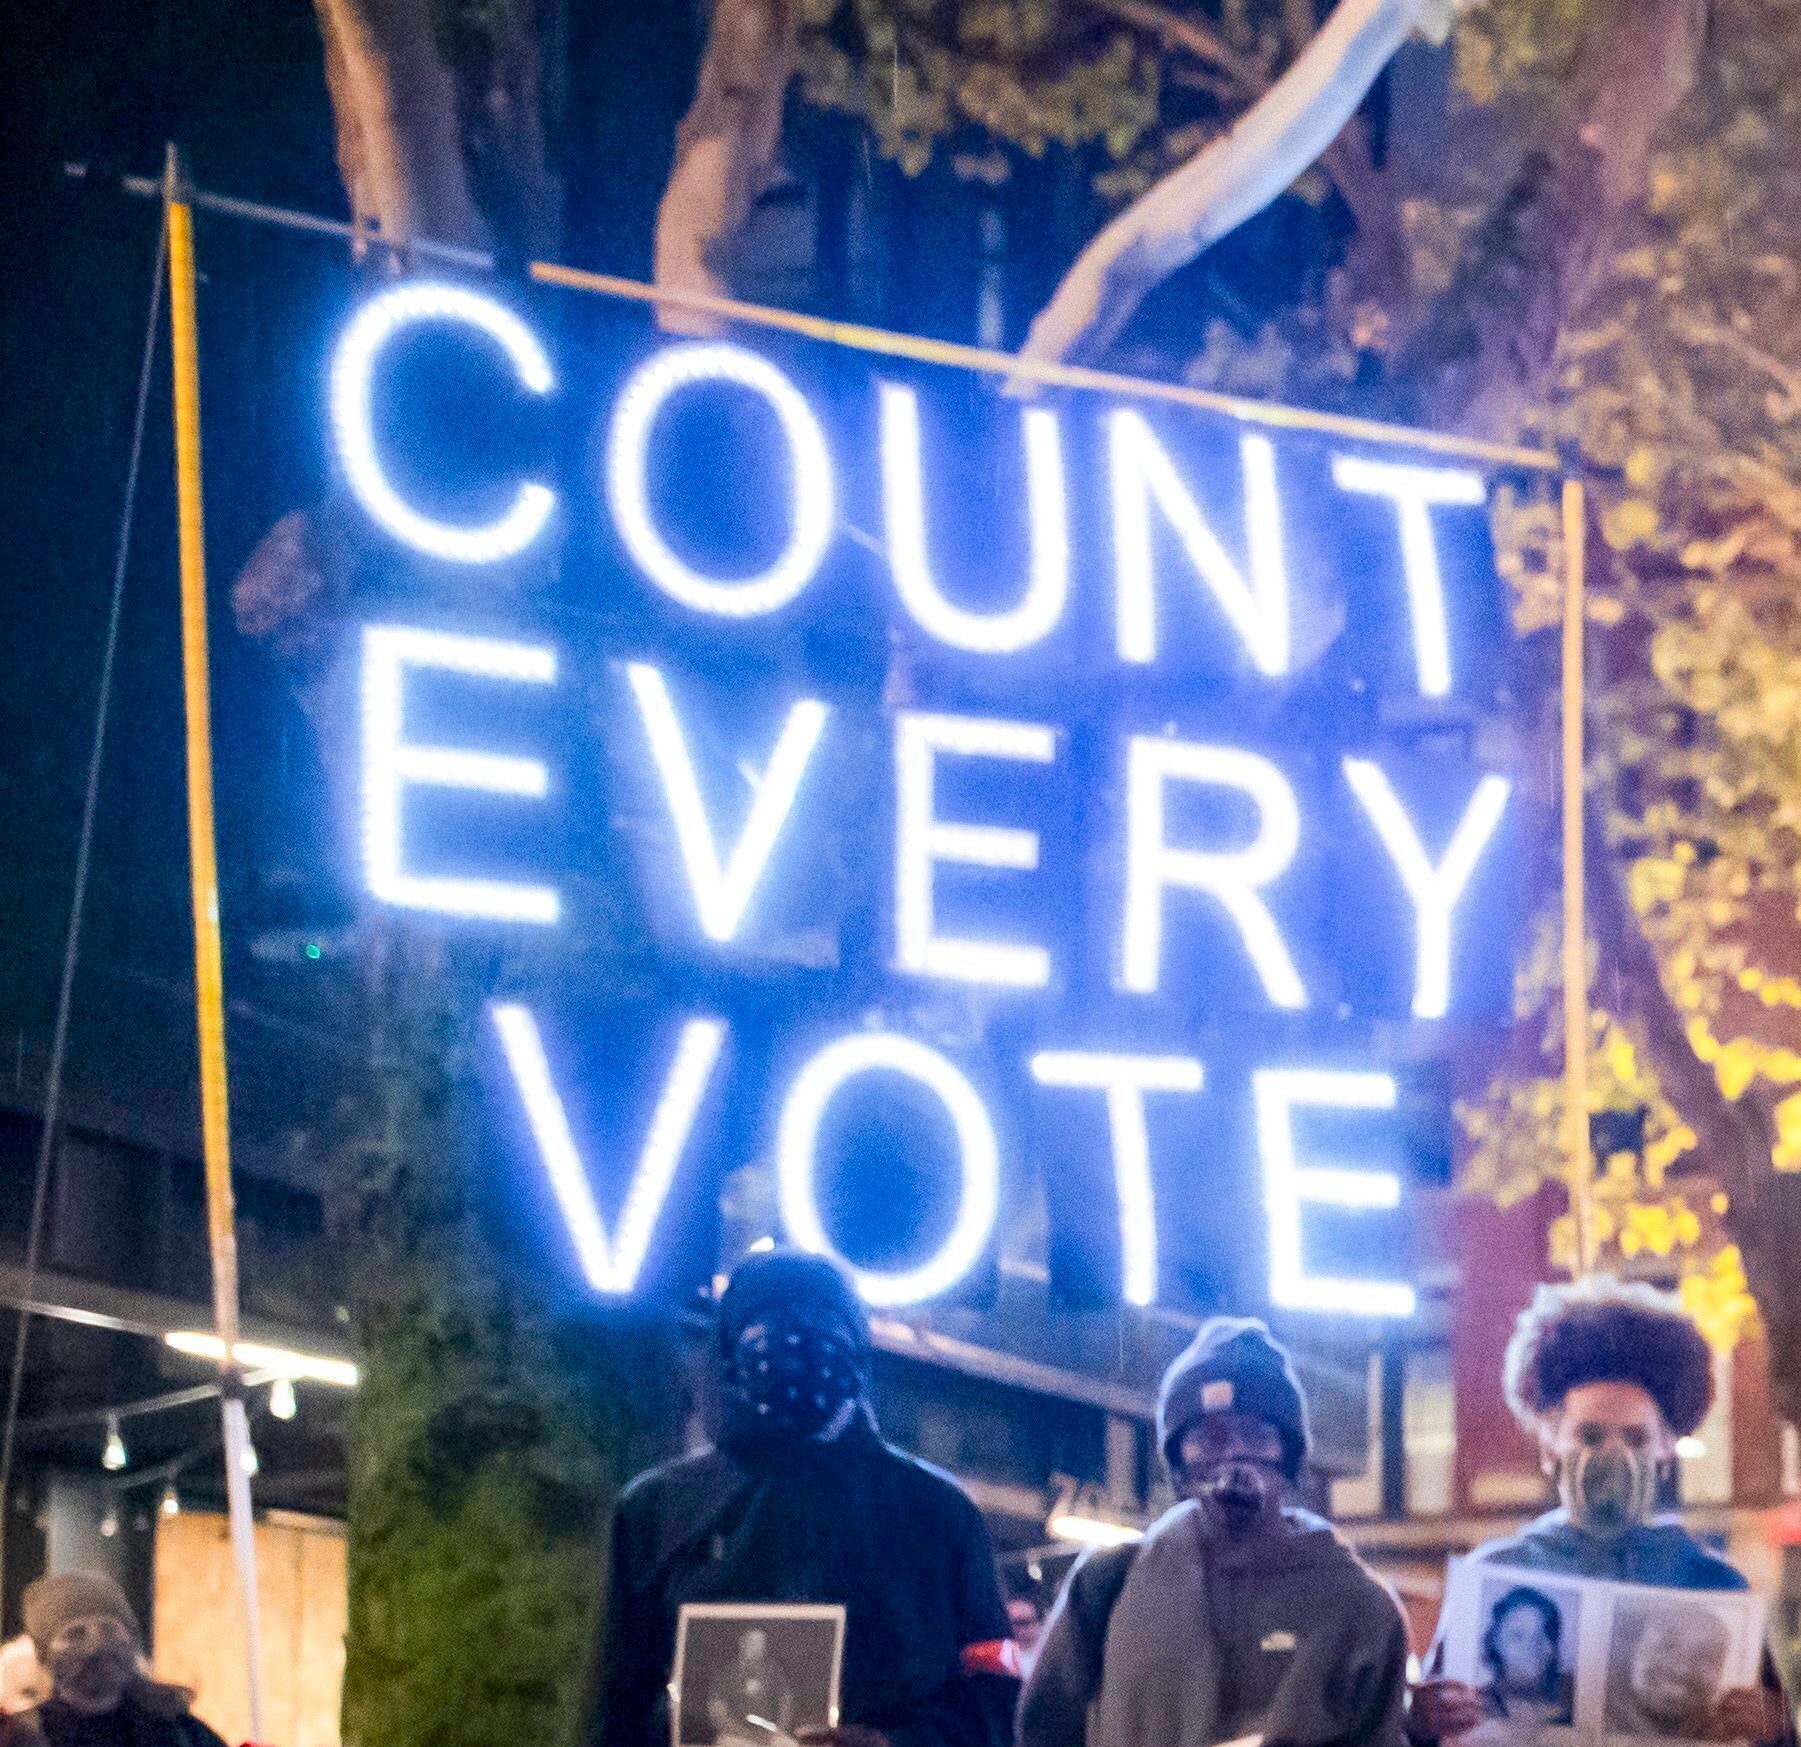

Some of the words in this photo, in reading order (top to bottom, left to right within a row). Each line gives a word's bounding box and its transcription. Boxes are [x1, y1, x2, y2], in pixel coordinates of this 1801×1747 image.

[322, 276, 1490, 700] COUNT
[356, 620, 1512, 1020] EVERY
[487, 1000, 1418, 1320] VOTE
